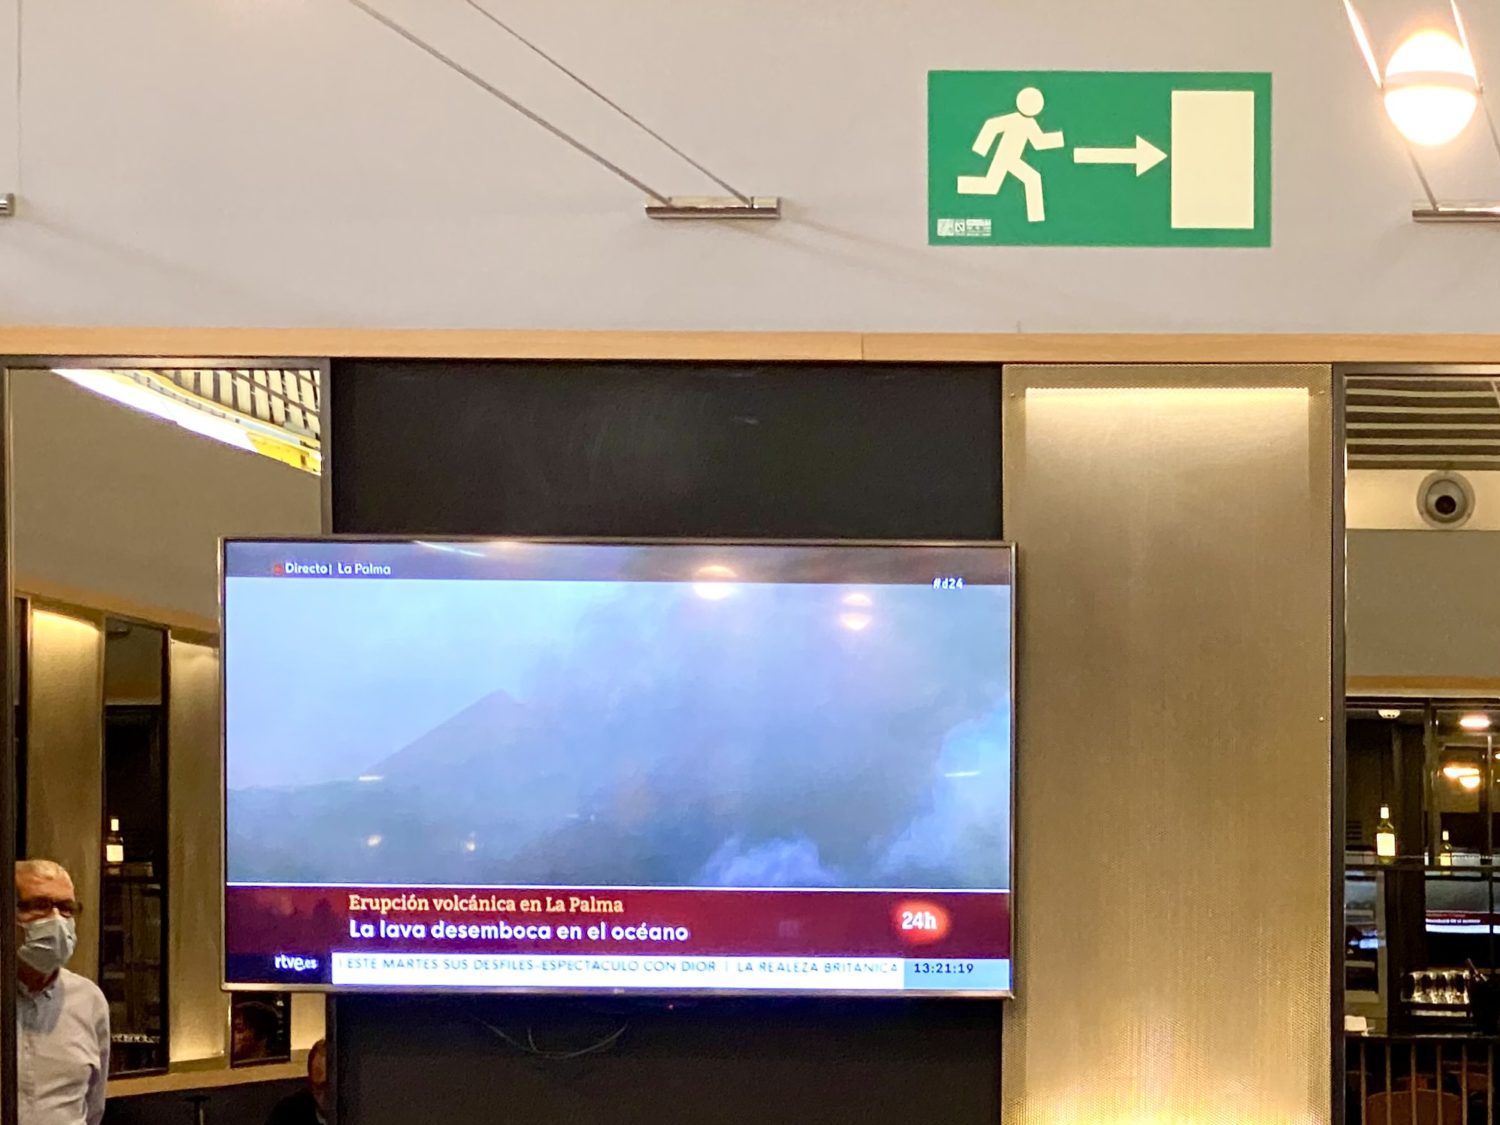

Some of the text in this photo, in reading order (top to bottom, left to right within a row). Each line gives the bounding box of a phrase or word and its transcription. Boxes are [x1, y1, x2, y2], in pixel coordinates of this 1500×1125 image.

[285, 562, 391, 575] Directo La Palma
[349, 893, 624, 914] Erupción volcánica en La Palma
[902, 911, 937, 930] 24h
[350, 919, 689, 941] La lava desemboca en el océano
[347, 958, 376, 969] ESTE
[384, 958, 438, 970] MARTES
[443, 959, 468, 970] SUS
[643, 960, 676, 971] CON
[682, 960, 715, 972] DIOR
[738, 961, 753, 972] LA
[759, 961, 818, 973] REALEZA
[914, 962, 974, 974] 13:21:19
